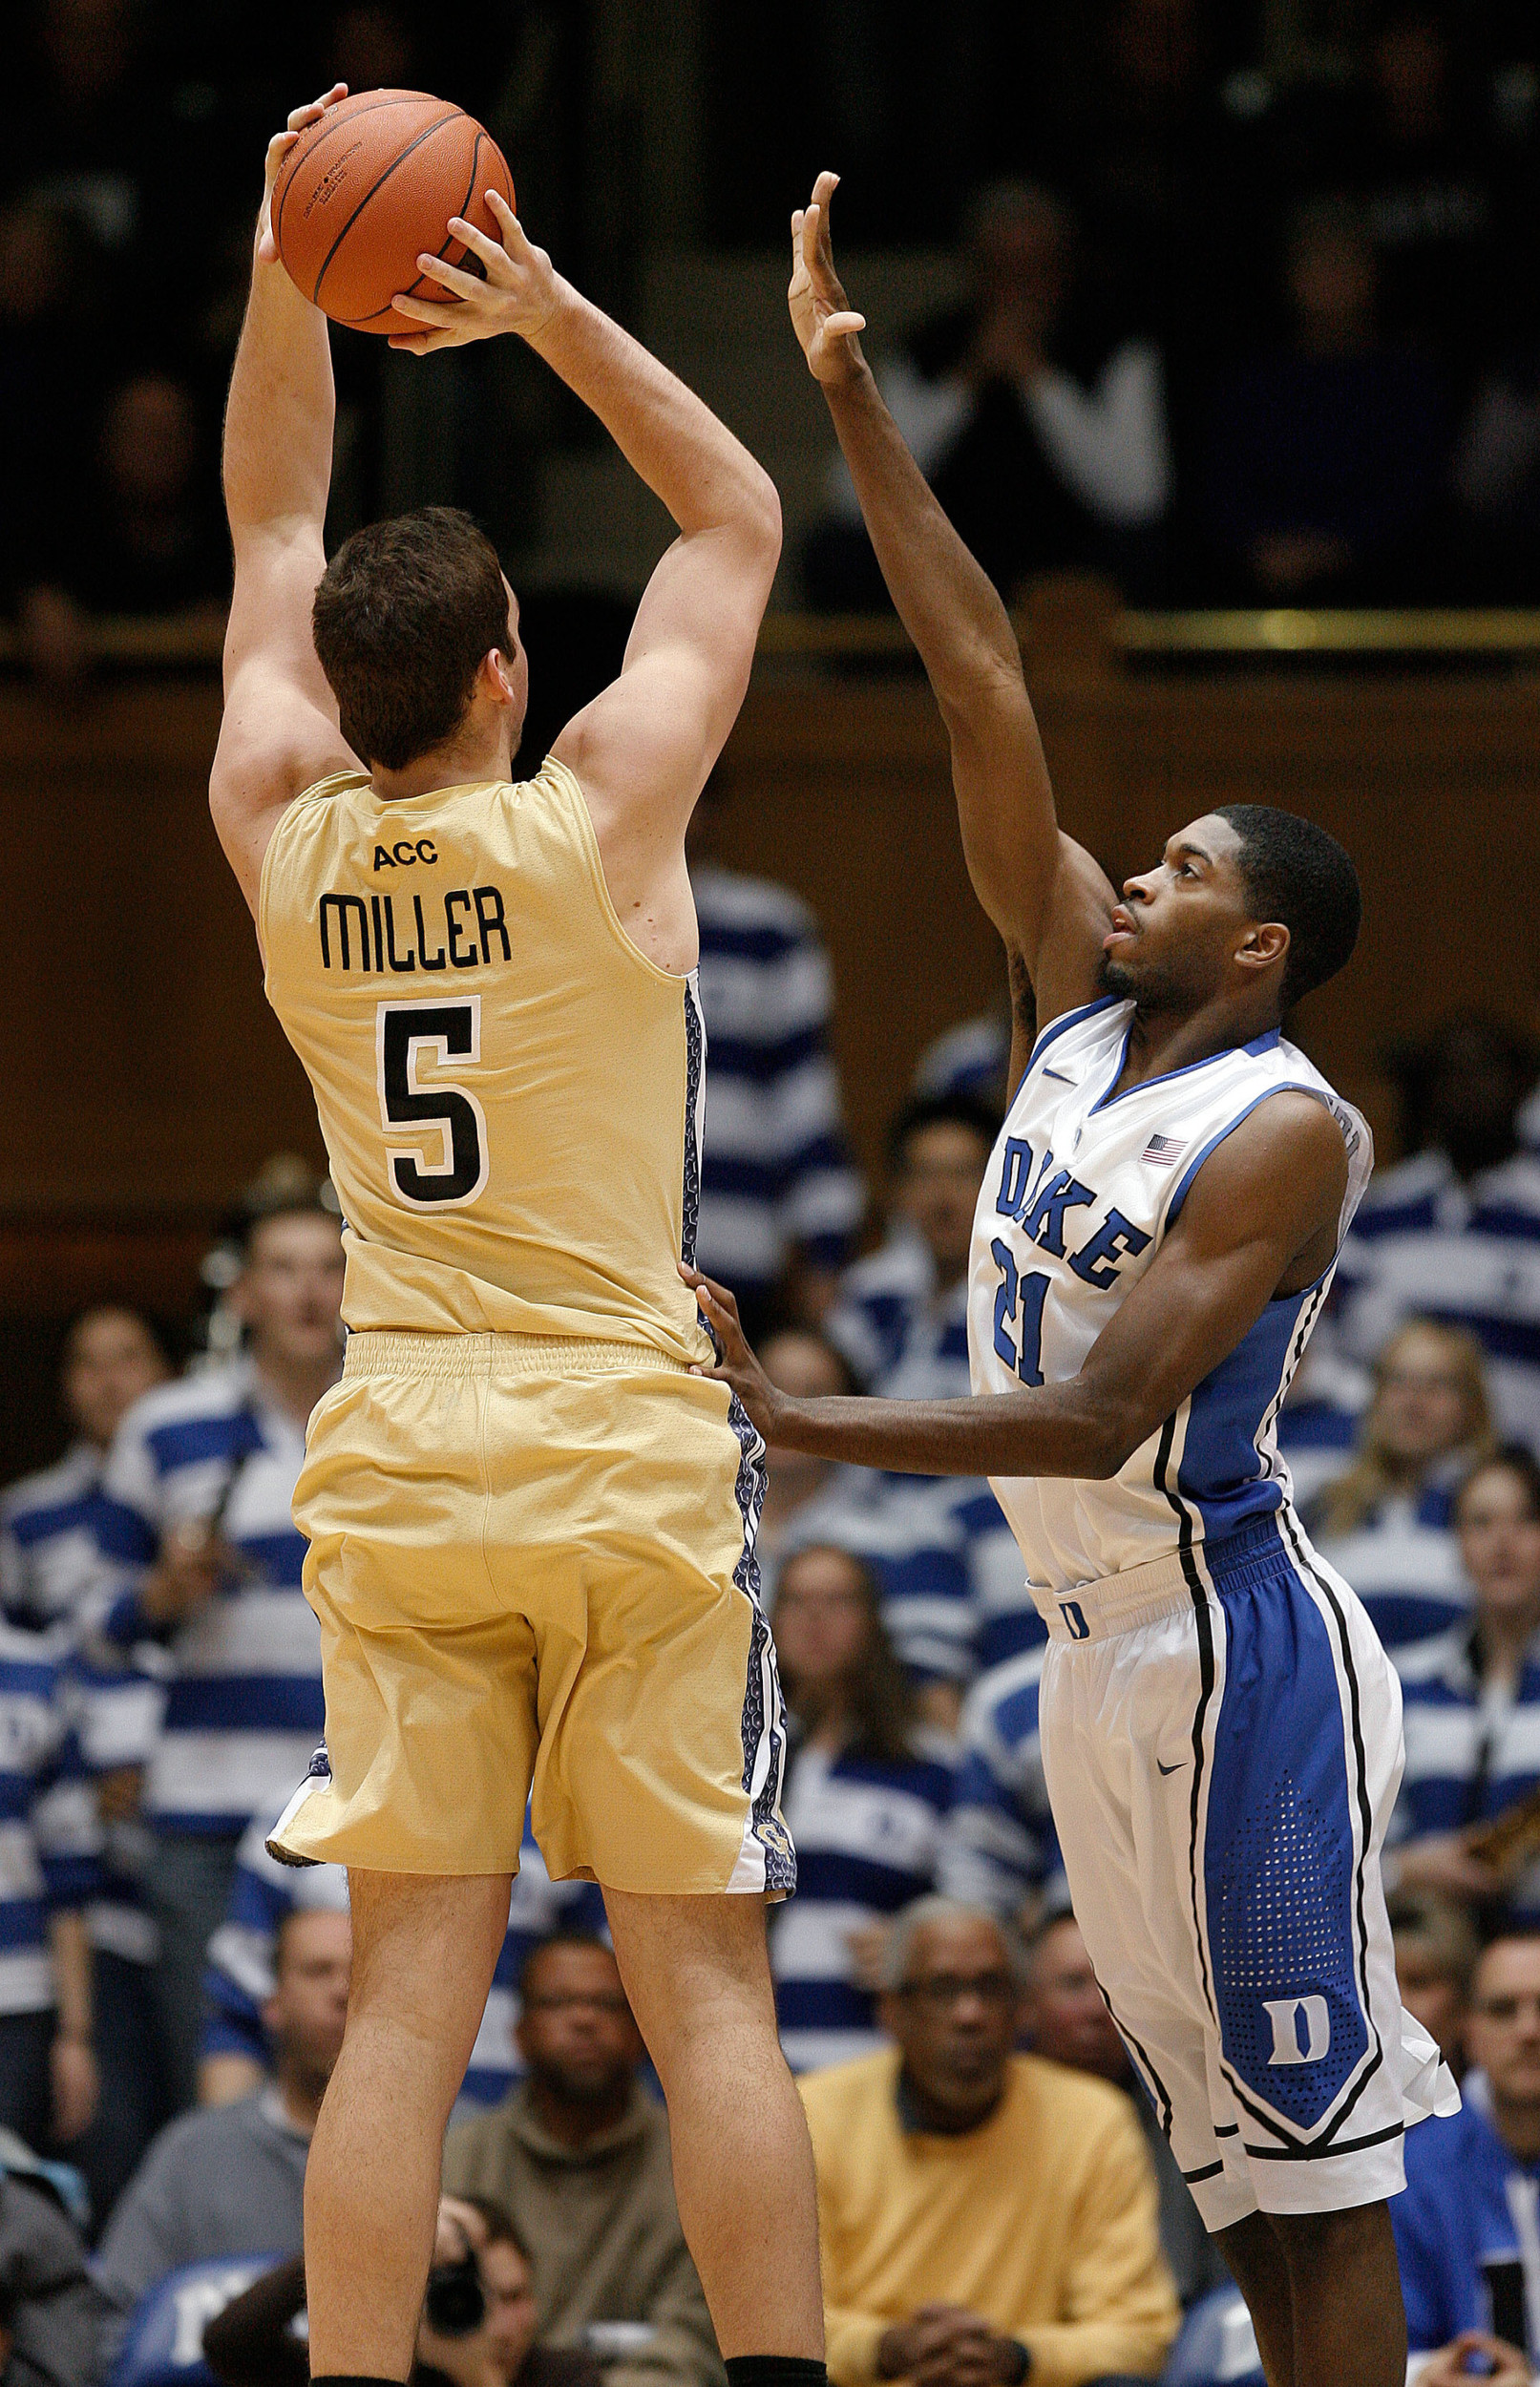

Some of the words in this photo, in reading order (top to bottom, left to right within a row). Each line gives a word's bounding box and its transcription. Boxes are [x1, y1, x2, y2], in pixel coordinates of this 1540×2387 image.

[372, 838, 439, 872] ACC
[319, 885, 513, 973] MILLER
[376, 994, 491, 1212] 5
[990, 1236, 1052, 1388] 21
[1262, 1995, 1331, 2064] D
